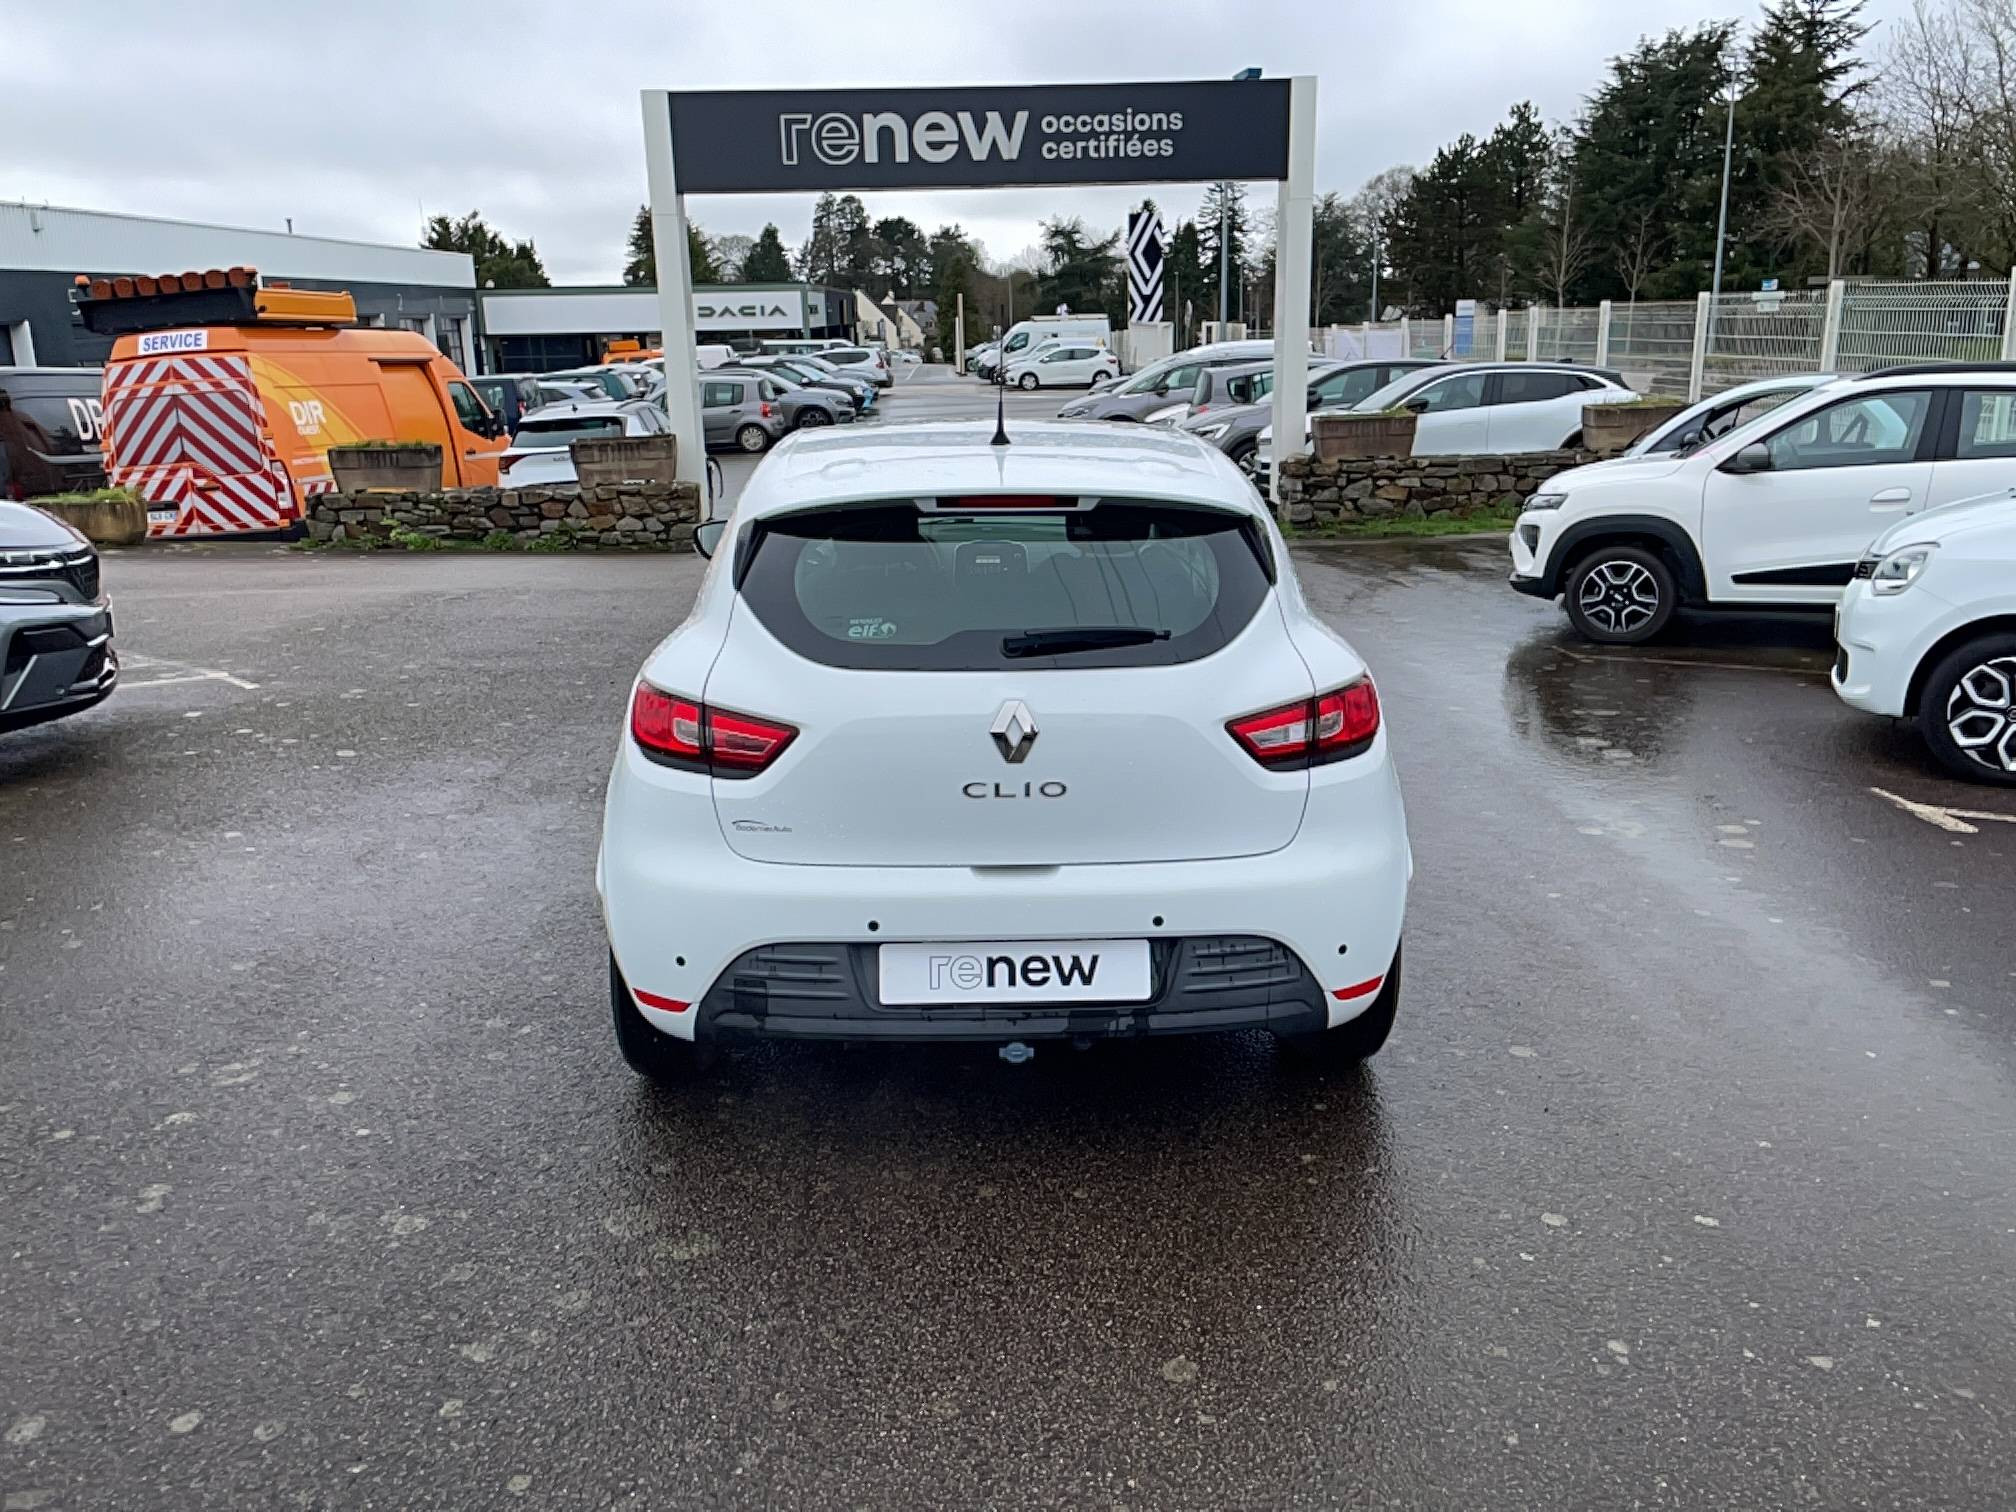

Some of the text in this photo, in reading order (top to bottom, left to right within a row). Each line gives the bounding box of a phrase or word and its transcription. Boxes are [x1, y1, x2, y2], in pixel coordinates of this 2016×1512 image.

[1041, 108, 1184, 134] occasions
[779, 110, 1029, 166] renew
[1041, 134, 1174, 160] certifiées
[697, 305, 788, 318] DACIA
[143, 332, 203, 352] SERVICE
[288, 400, 327, 425] DIR
[962, 781, 1067, 799] CLIO
[929, 954, 1100, 990] renew
